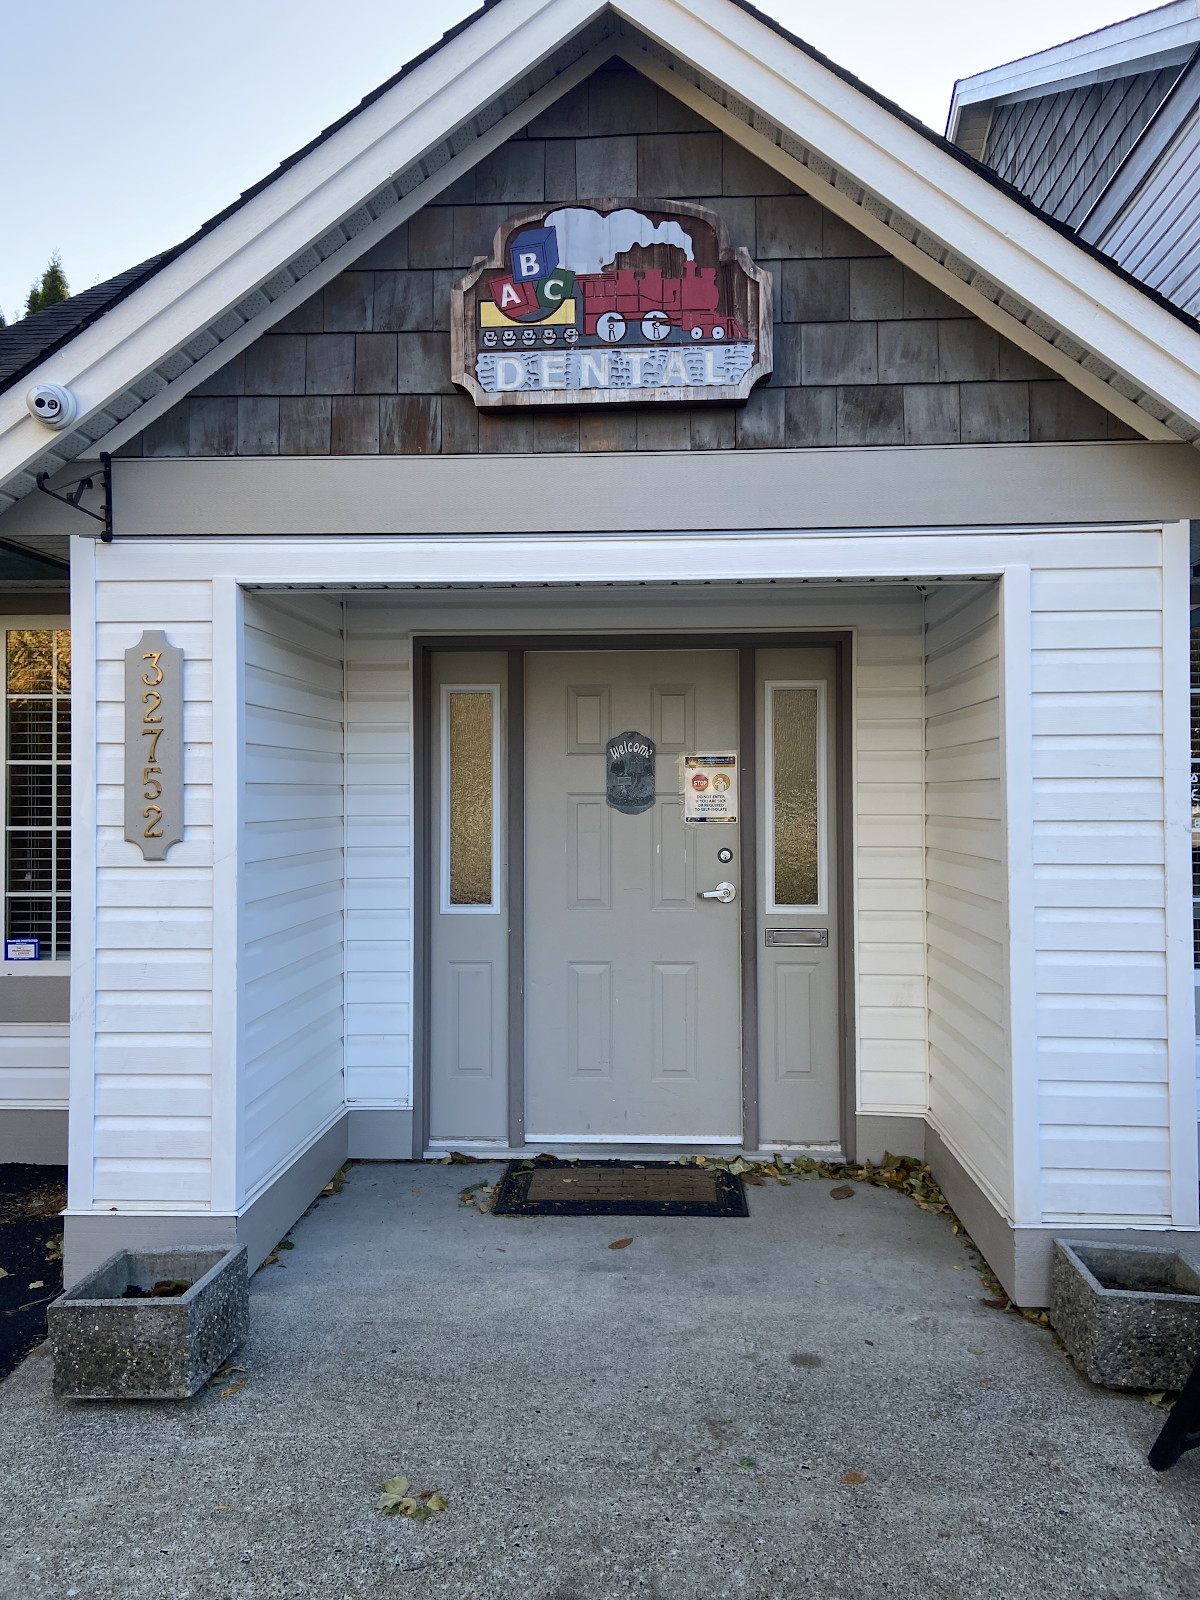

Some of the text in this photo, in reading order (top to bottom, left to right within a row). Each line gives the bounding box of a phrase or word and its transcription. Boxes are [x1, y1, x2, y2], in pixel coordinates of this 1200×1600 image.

[518, 252, 540, 277] B
[500, 280, 564, 307] A C
[496, 349, 727, 388] DENTAL
[141, 652, 164, 838] 32752
